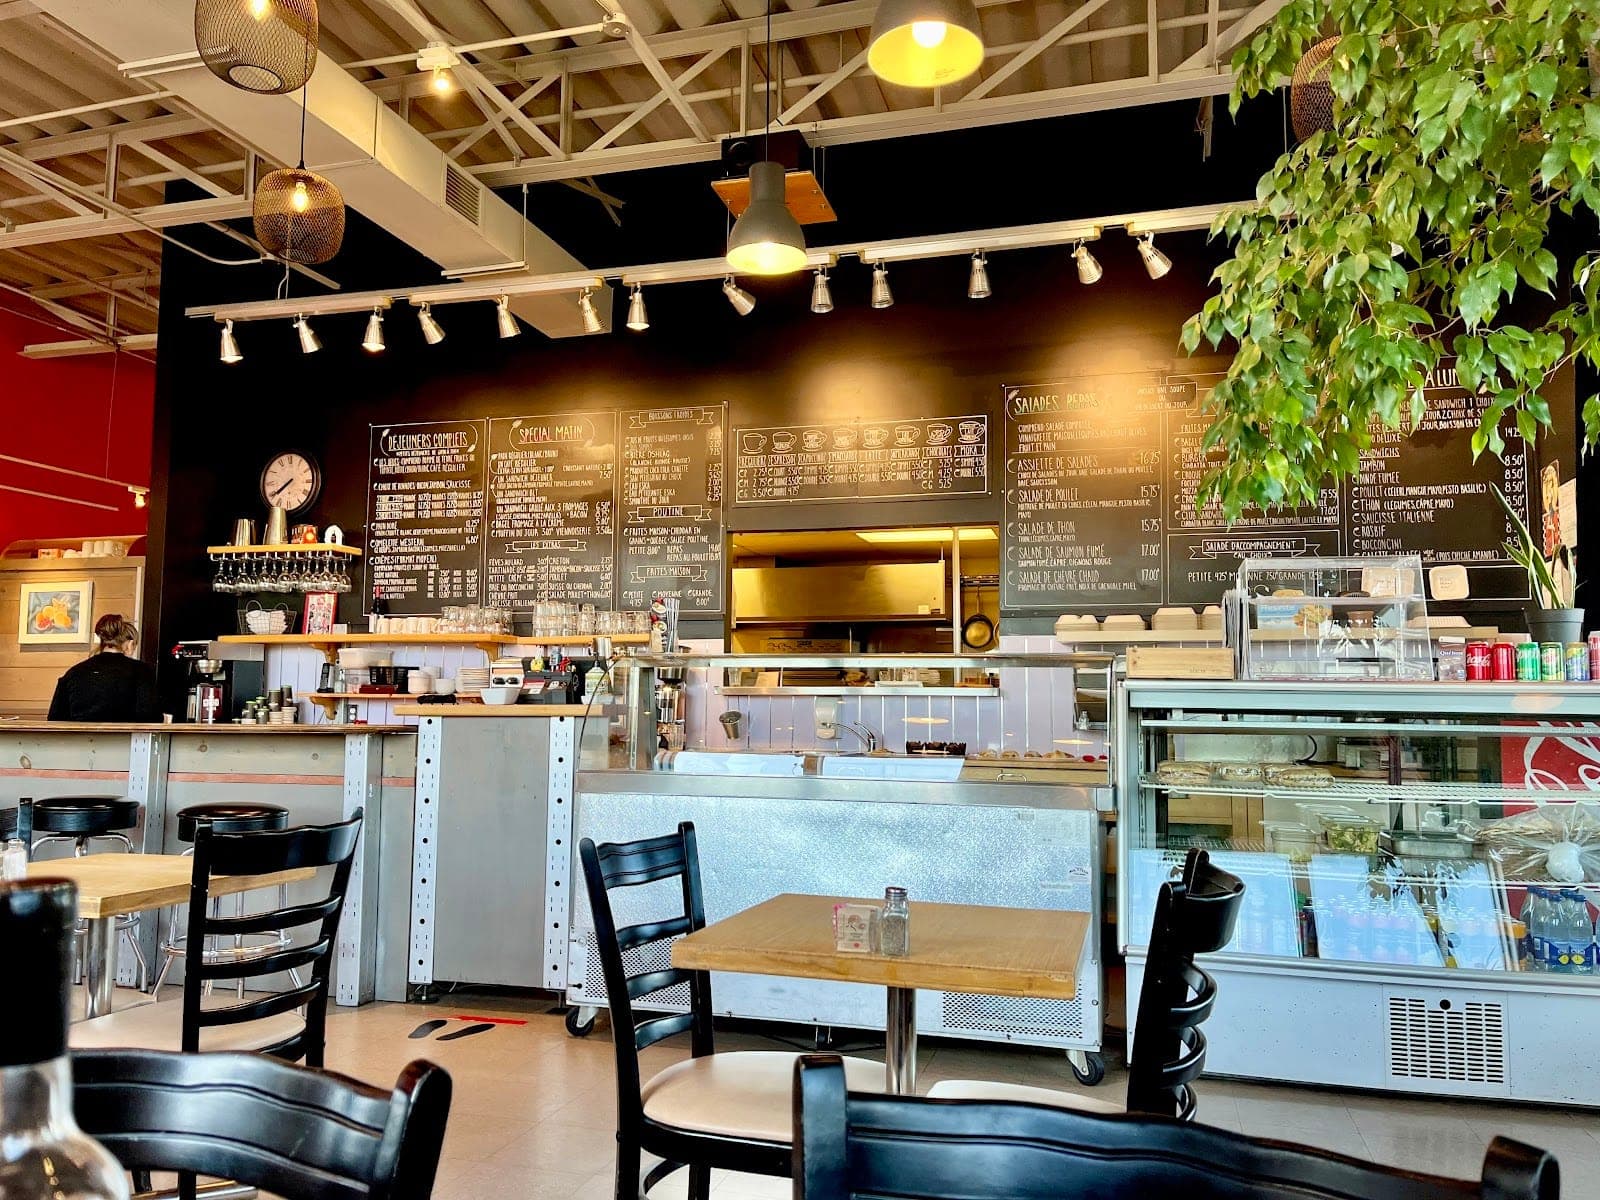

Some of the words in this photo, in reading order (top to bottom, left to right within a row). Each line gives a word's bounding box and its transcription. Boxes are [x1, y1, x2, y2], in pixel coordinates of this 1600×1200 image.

[1170, 385, 1186, 393] SOUPE
[1015, 395, 1059, 414] SALADES
[1434, 397, 1465, 410] SANDWICH
[1045, 422, 1064, 431] SALADE
[555, 425, 583, 440] MATIN
[433, 432, 467, 447] COMPLETS
[961, 446, 977, 455] MOKA
[1017, 458, 1053, 472] ASSIETTE
[1056, 457, 1064, 469] DE
[1067, 455, 1098, 469] SALADES
[1181, 454, 1207, 462] BURGER
[1360, 460, 1386, 471] JAMBON
[1360, 472, 1377, 484] DINDE
[928, 481, 933, 489] G
[1019, 489, 1044, 502] SALADE
[1045, 489, 1052, 502] DE
[1056, 488, 1078, 501] POULET
[1360, 486, 1383, 497] POULET
[557, 503, 561, 511] 3
[563, 502, 588, 510] FROMAGES
[1361, 499, 1381, 511] THON
[653, 507, 683, 517] POUTINE
[1361, 512, 1396, 523] SAUCISSE
[1399, 510, 1435, 523] ITALIENNE
[630, 528, 647, 536] FRITES
[1018, 522, 1045, 535] SALADE
[1047, 522, 1054, 535] DE
[1058, 521, 1075, 534] THON
[1361, 525, 1386, 537] ROSBIF
[1206, 543, 1228, 551] SALADE
[1362, 538, 1402, 550] BOCCONCINI
[629, 546, 645, 554] PETITE
[1018, 546, 1042, 559] SALADE
[1045, 546, 1052, 559] DE
[1056, 545, 1085, 558] SAUMON
[667, 554, 682, 562] REPAS
[549, 573, 567, 581] POULET
[647, 568, 667, 576] FRITES
[669, 567, 690, 575] MAISON
[1018, 570, 1042, 584] SALADE
[1044, 570, 1052, 583] DE
[1078, 570, 1100, 582] CHAUD
[1188, 572, 1213, 582] PETITE
[1279, 570, 1305, 580] GRANDE
[489, 574, 504, 582] PETITE
[549, 582, 564, 590] SUISSE
[549, 590, 565, 598] SALADE
